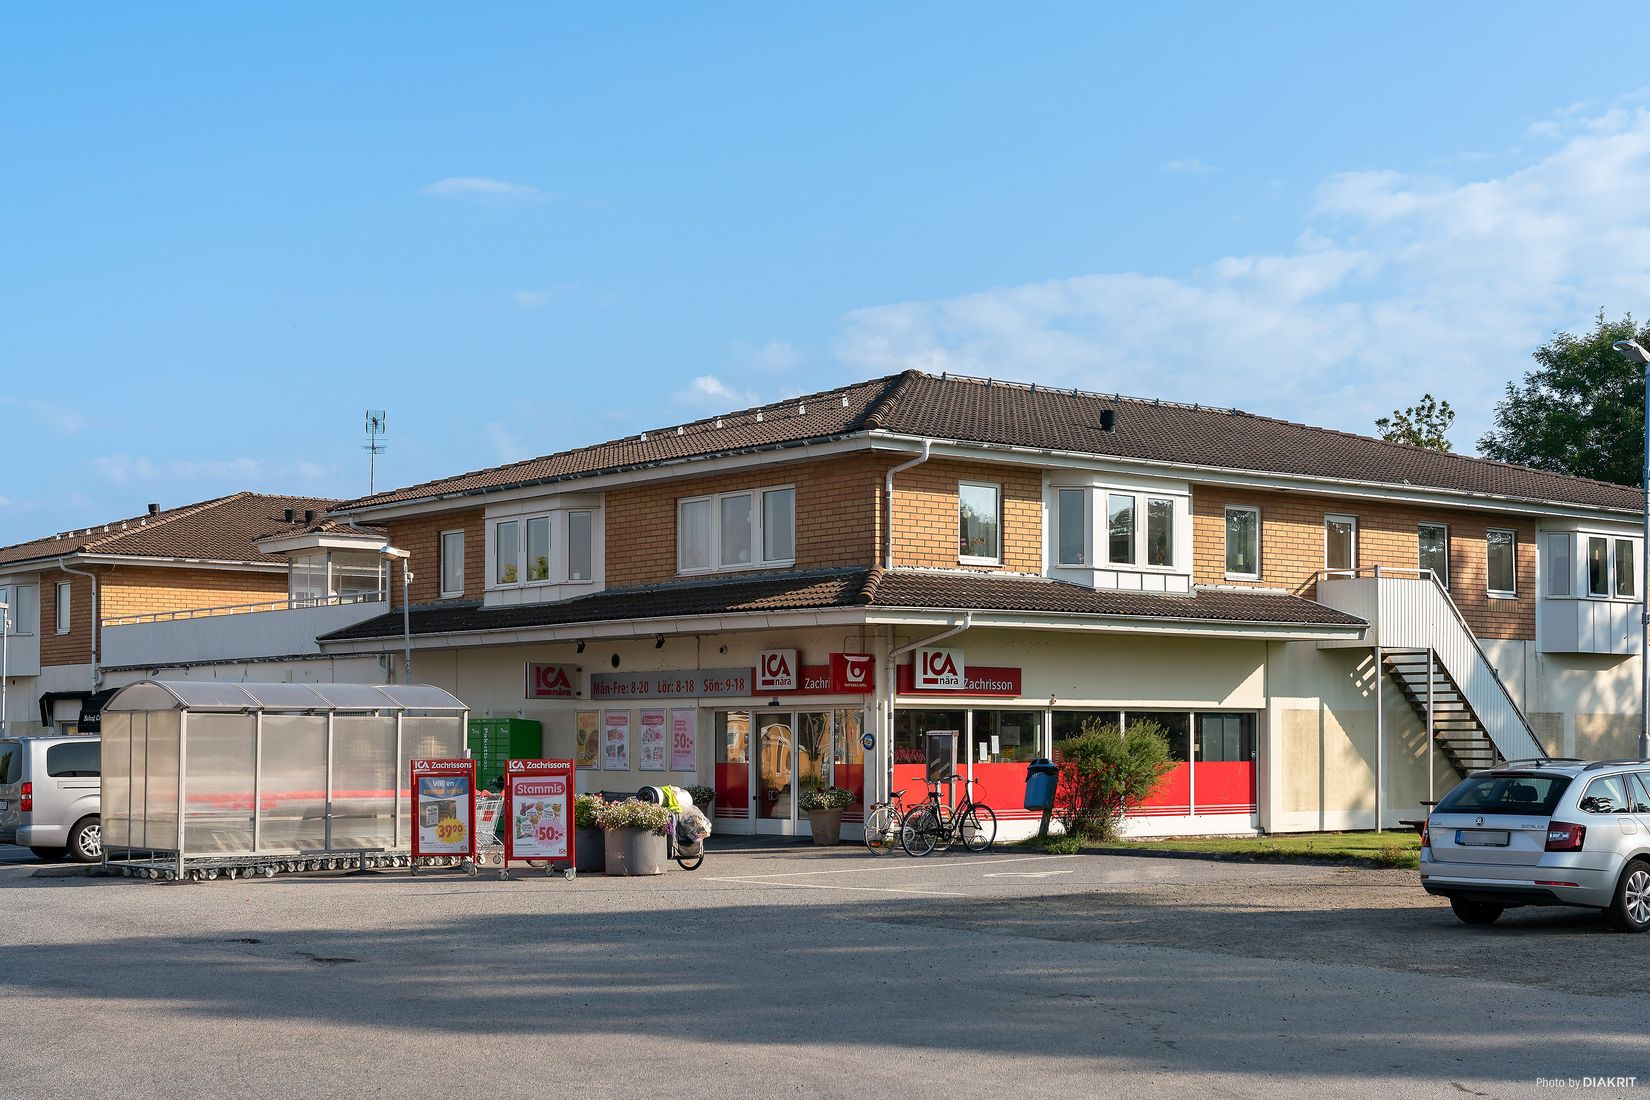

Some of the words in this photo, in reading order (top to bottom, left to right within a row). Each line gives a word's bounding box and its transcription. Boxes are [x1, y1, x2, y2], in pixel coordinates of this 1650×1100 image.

[761, 654, 791, 678] ICA
[923, 652, 958, 676] ICA
[535, 666, 571, 688] ICA
[775, 677, 791, 686] nära
[940, 675, 959, 685] nära
[631, 681, 648, 694] 8-20
[657, 680, 674, 693] Lör:
[676, 680, 695, 693] 8-18
[703, 679, 723, 692] Sön:
[725, 679, 745, 692] 9-18
[963, 678, 1013, 690] Zachrisson
[674, 733, 693, 748] 50:-
[415, 761, 429, 769] ICA
[509, 761, 525, 769] ICA
[526, 761, 571, 769] Zachrissons
[517, 784, 562, 794] Stammis
[539, 826, 563, 841] 50:-
